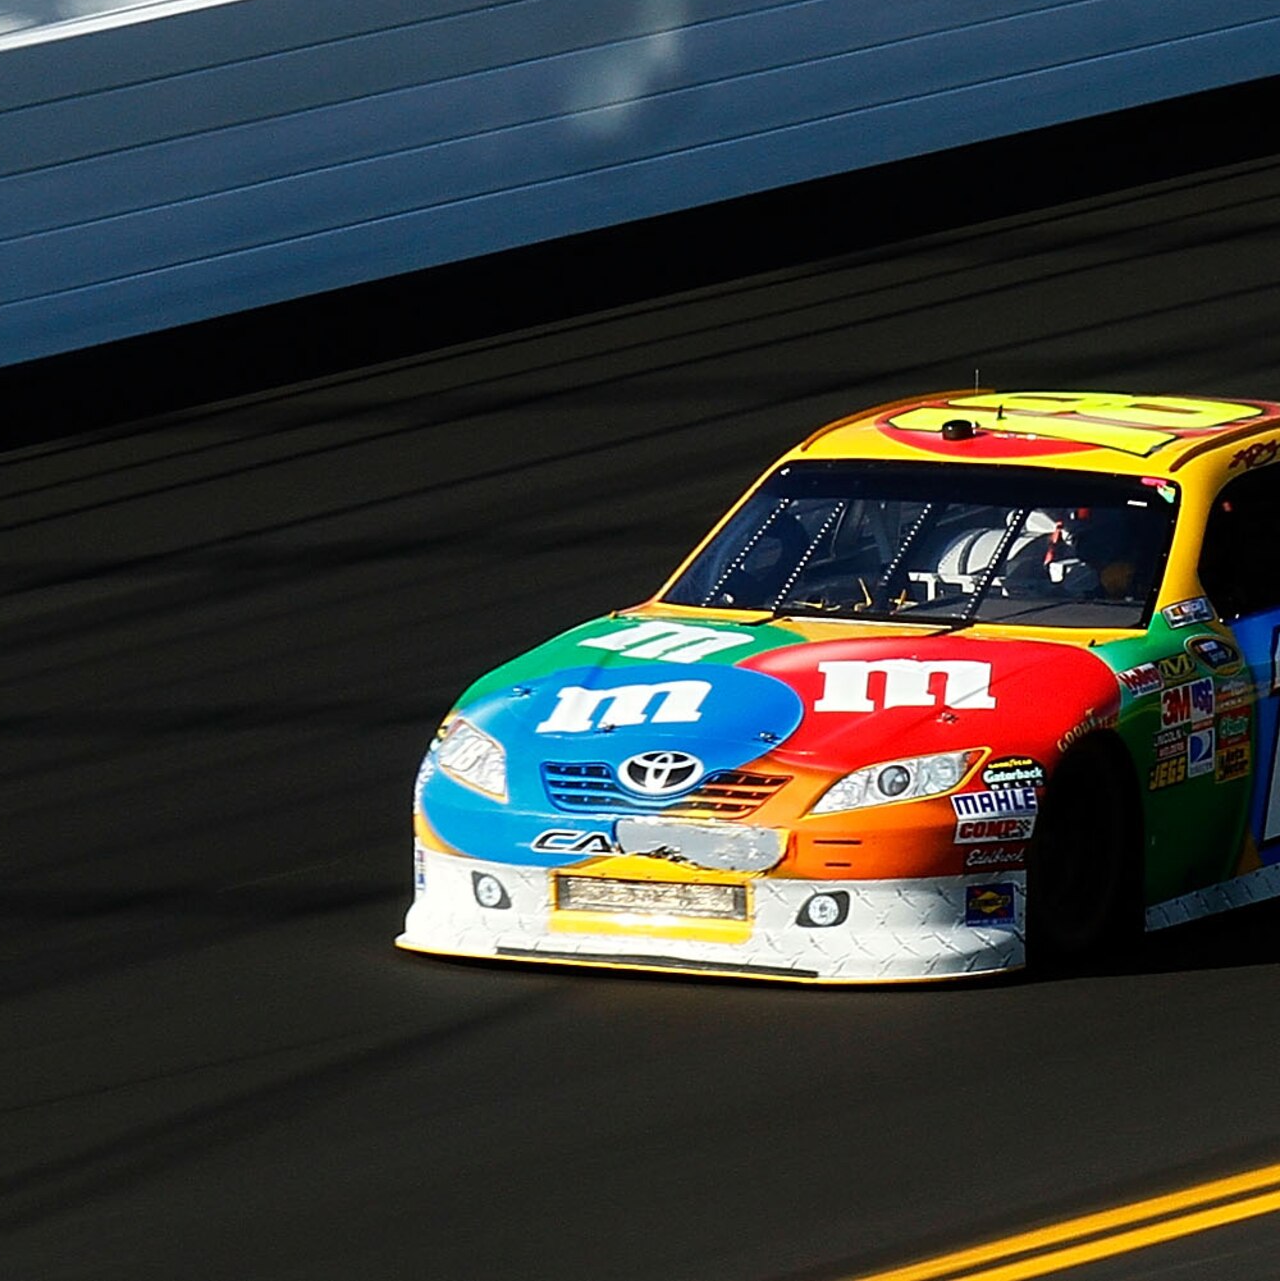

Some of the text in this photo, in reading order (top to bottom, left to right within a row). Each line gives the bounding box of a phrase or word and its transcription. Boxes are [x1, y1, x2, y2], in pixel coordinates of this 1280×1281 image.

[886, 391, 1266, 458] 18
[576, 621, 755, 665] m
[534, 680, 713, 734] m
[813, 658, 997, 714] m
[1162, 685, 1191, 726] 3M
[983, 766, 1043, 784] Gatorback
[954, 788, 1036, 815] MAHLE
[959, 819, 1018, 839] COMP
